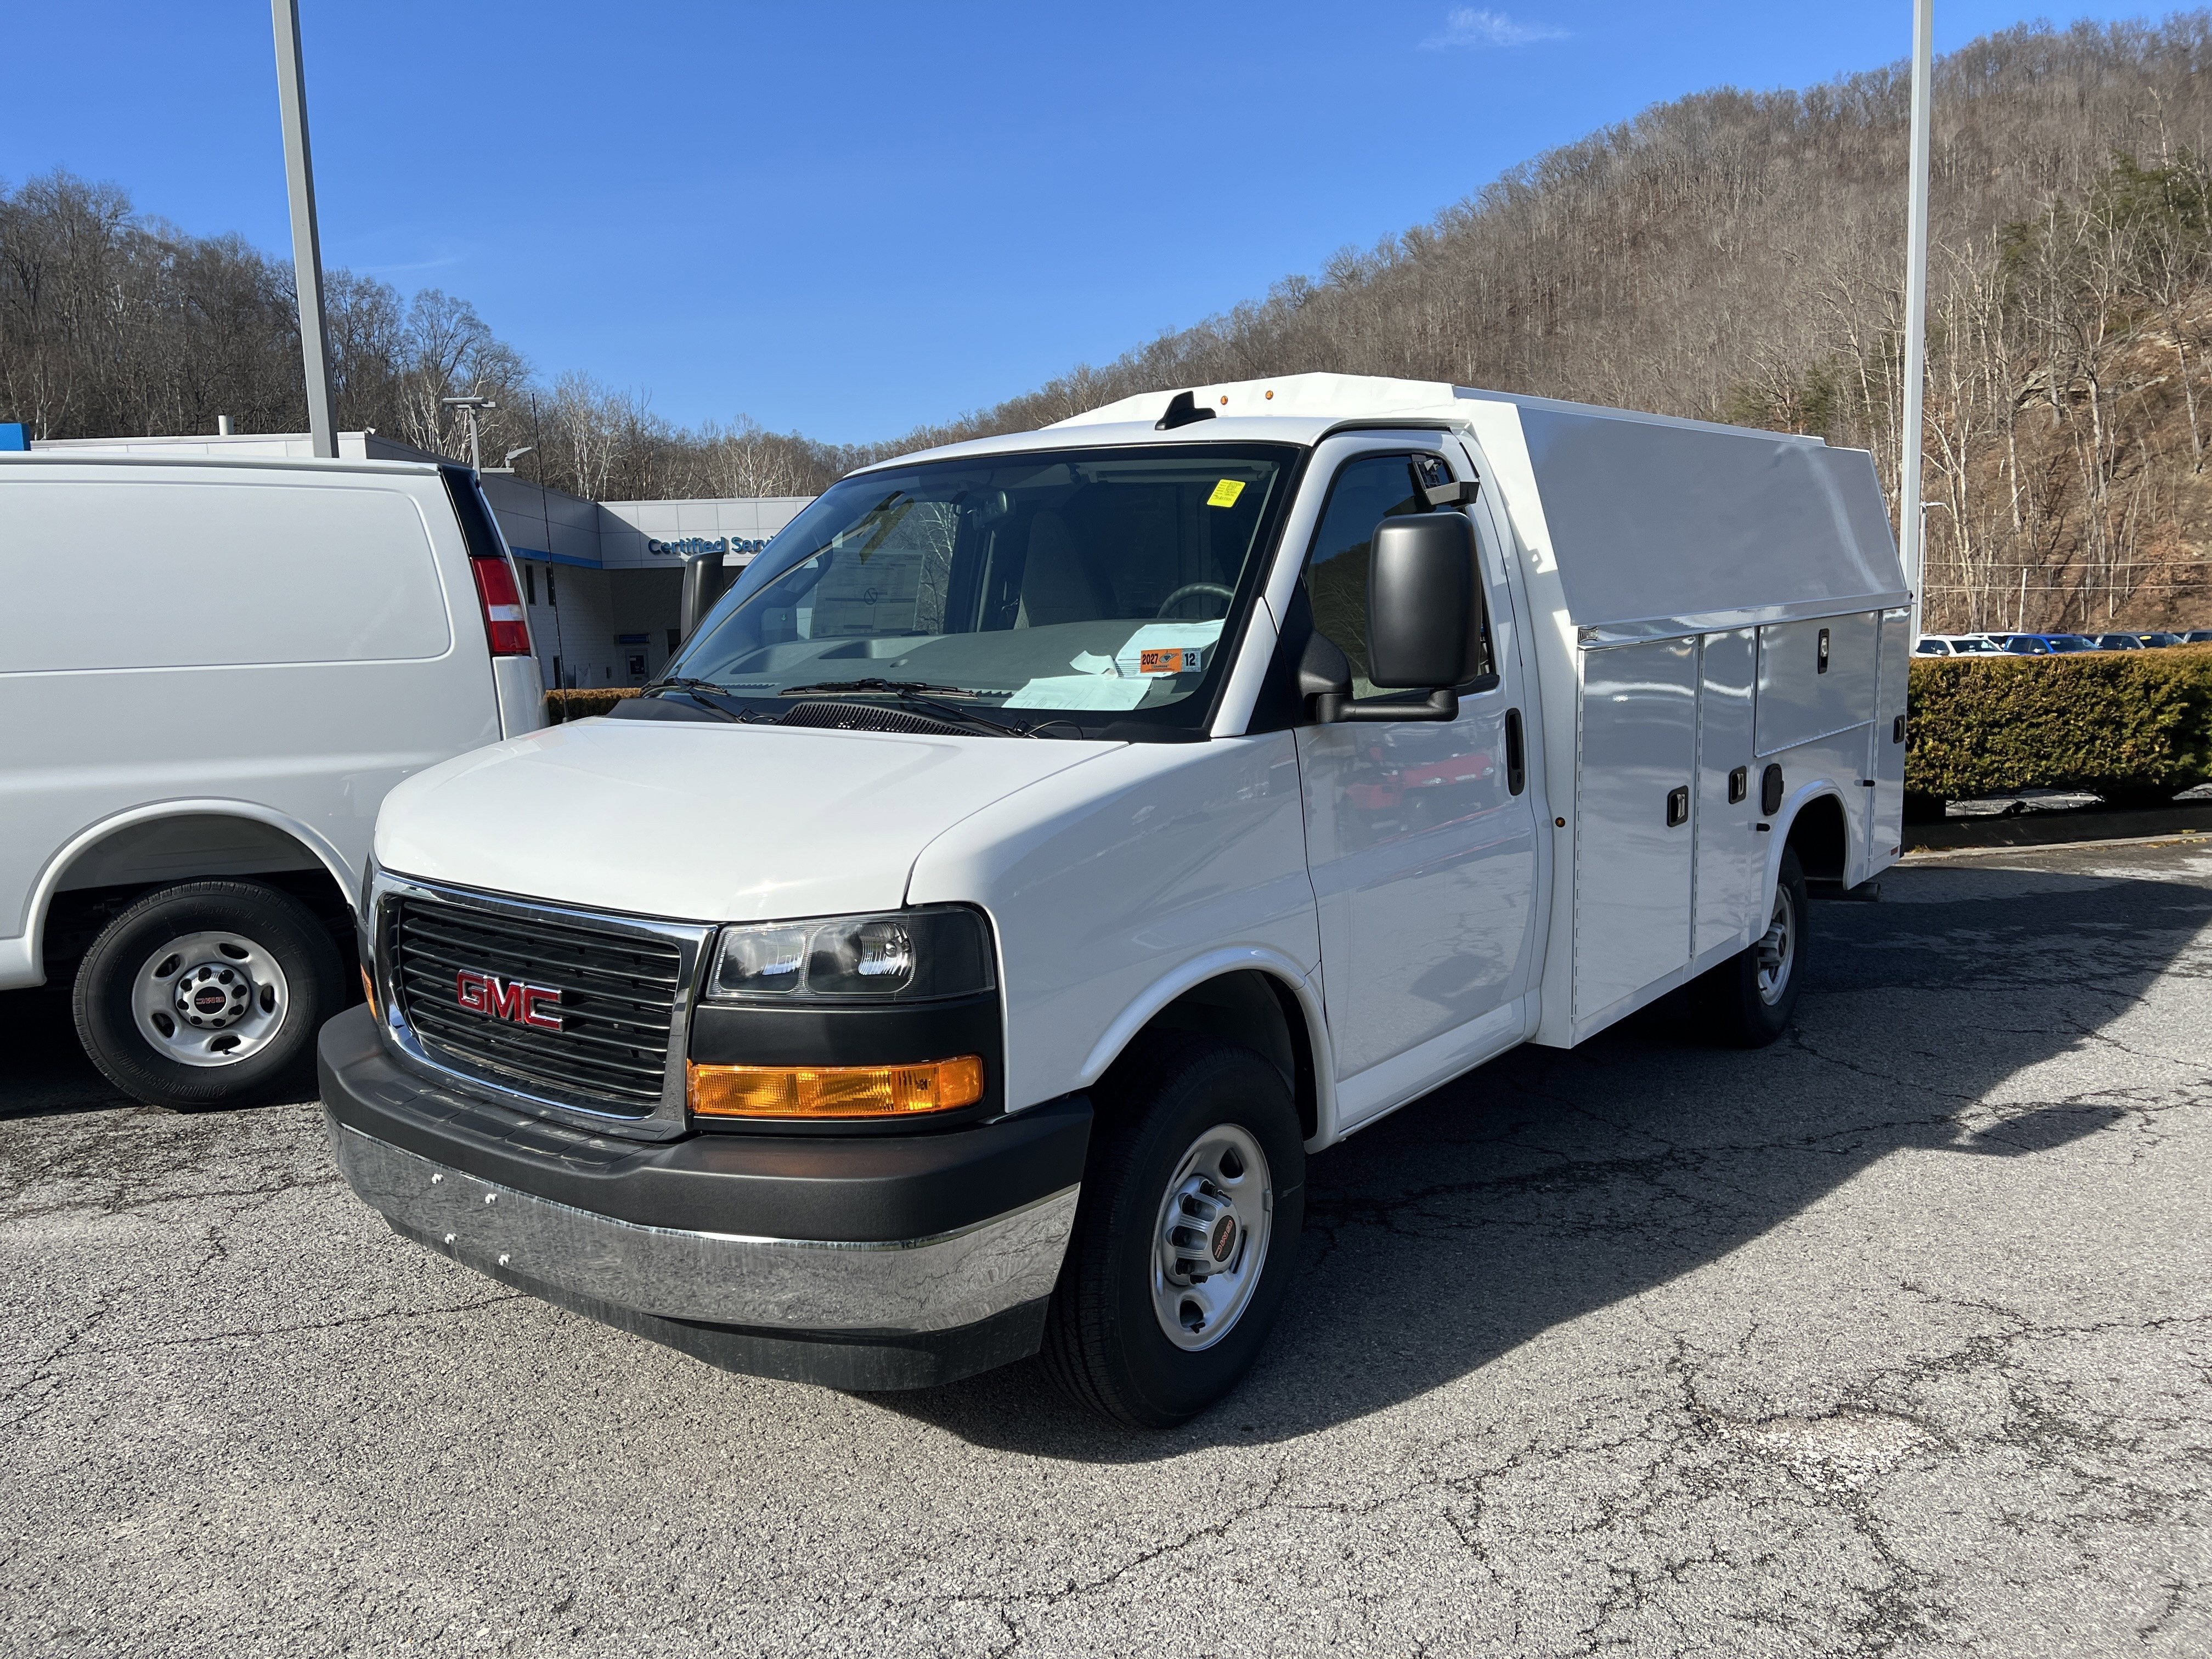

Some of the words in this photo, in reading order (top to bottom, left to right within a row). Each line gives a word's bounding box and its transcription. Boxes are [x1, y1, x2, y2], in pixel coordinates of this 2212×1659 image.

[648, 537, 726, 554] Certified
[1142, 653, 1159, 665] 2027
[1185, 653, 1195, 666] 12
[196, 996, 225, 1005] GMC
[457, 969, 563, 1031] GMC
[1214, 1220, 1233, 1259] GMC
